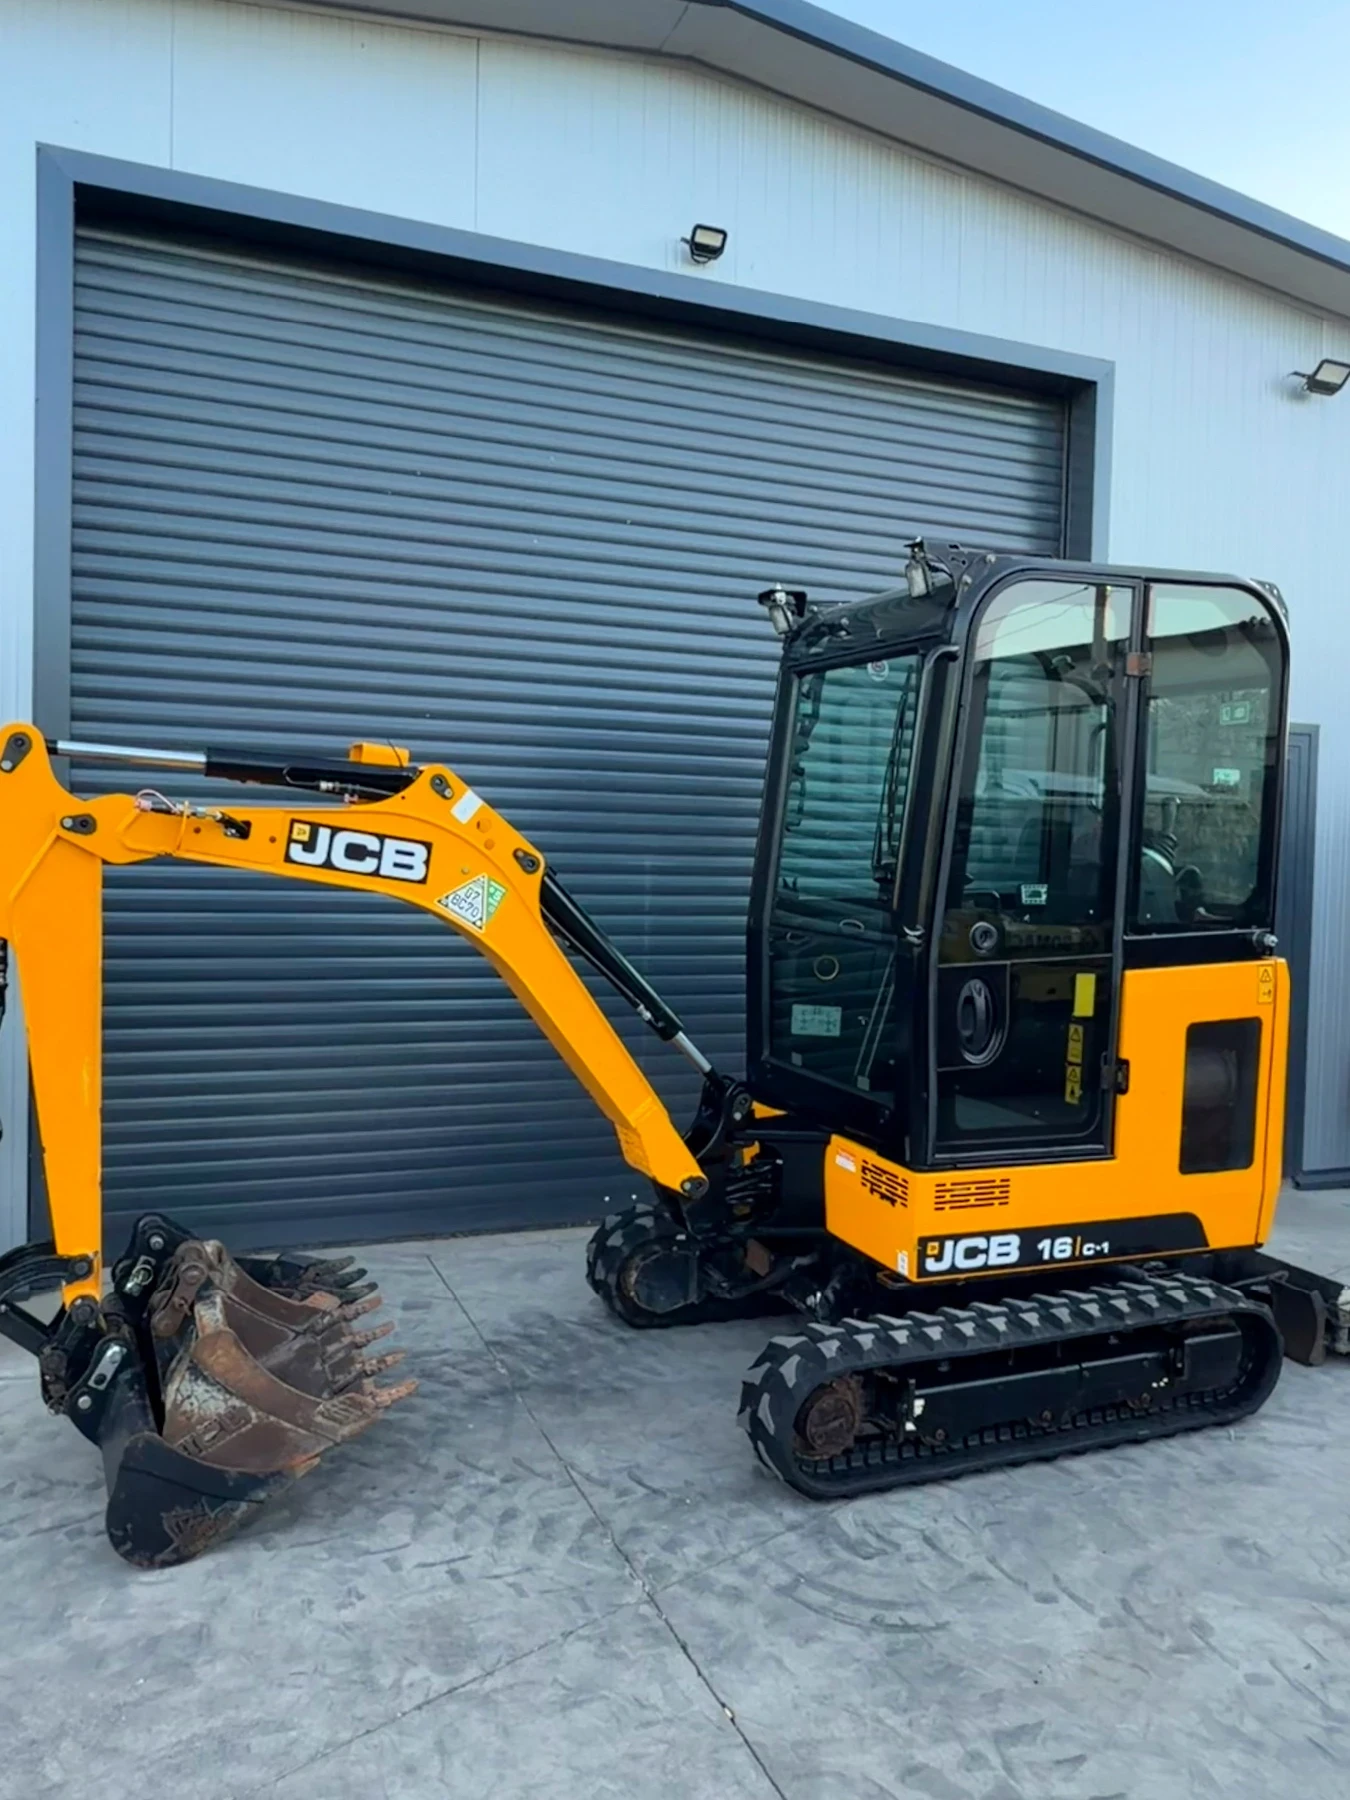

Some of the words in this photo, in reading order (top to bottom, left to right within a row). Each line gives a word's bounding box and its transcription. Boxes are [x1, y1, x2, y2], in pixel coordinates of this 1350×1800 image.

[288, 826, 428, 882] JCB
[925, 1234, 1021, 1272] JCB
[1037, 1235, 1073, 1260] 16
